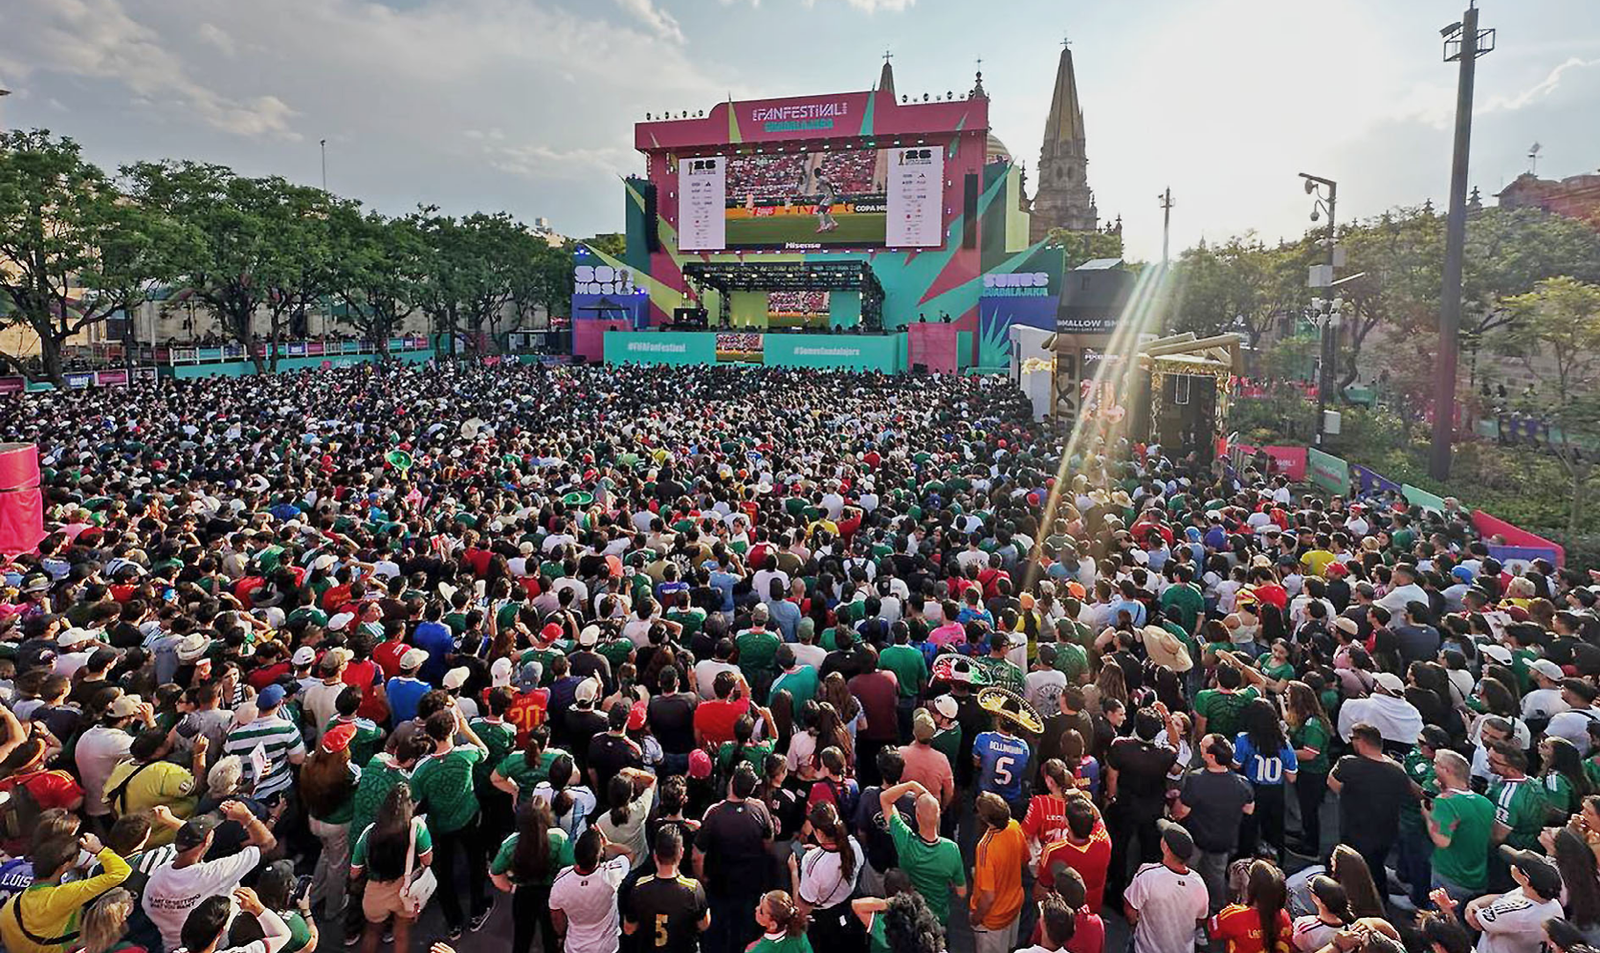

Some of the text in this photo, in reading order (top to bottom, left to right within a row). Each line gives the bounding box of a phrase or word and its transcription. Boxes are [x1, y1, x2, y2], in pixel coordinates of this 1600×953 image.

[785, 242, 821, 250] Hisense
[510, 704, 541, 732] 20
[994, 756, 1015, 785] 5
[1254, 754, 1282, 782] 10
[1, 872, 34, 888] LUIS
[655, 913, 668, 947] 5
